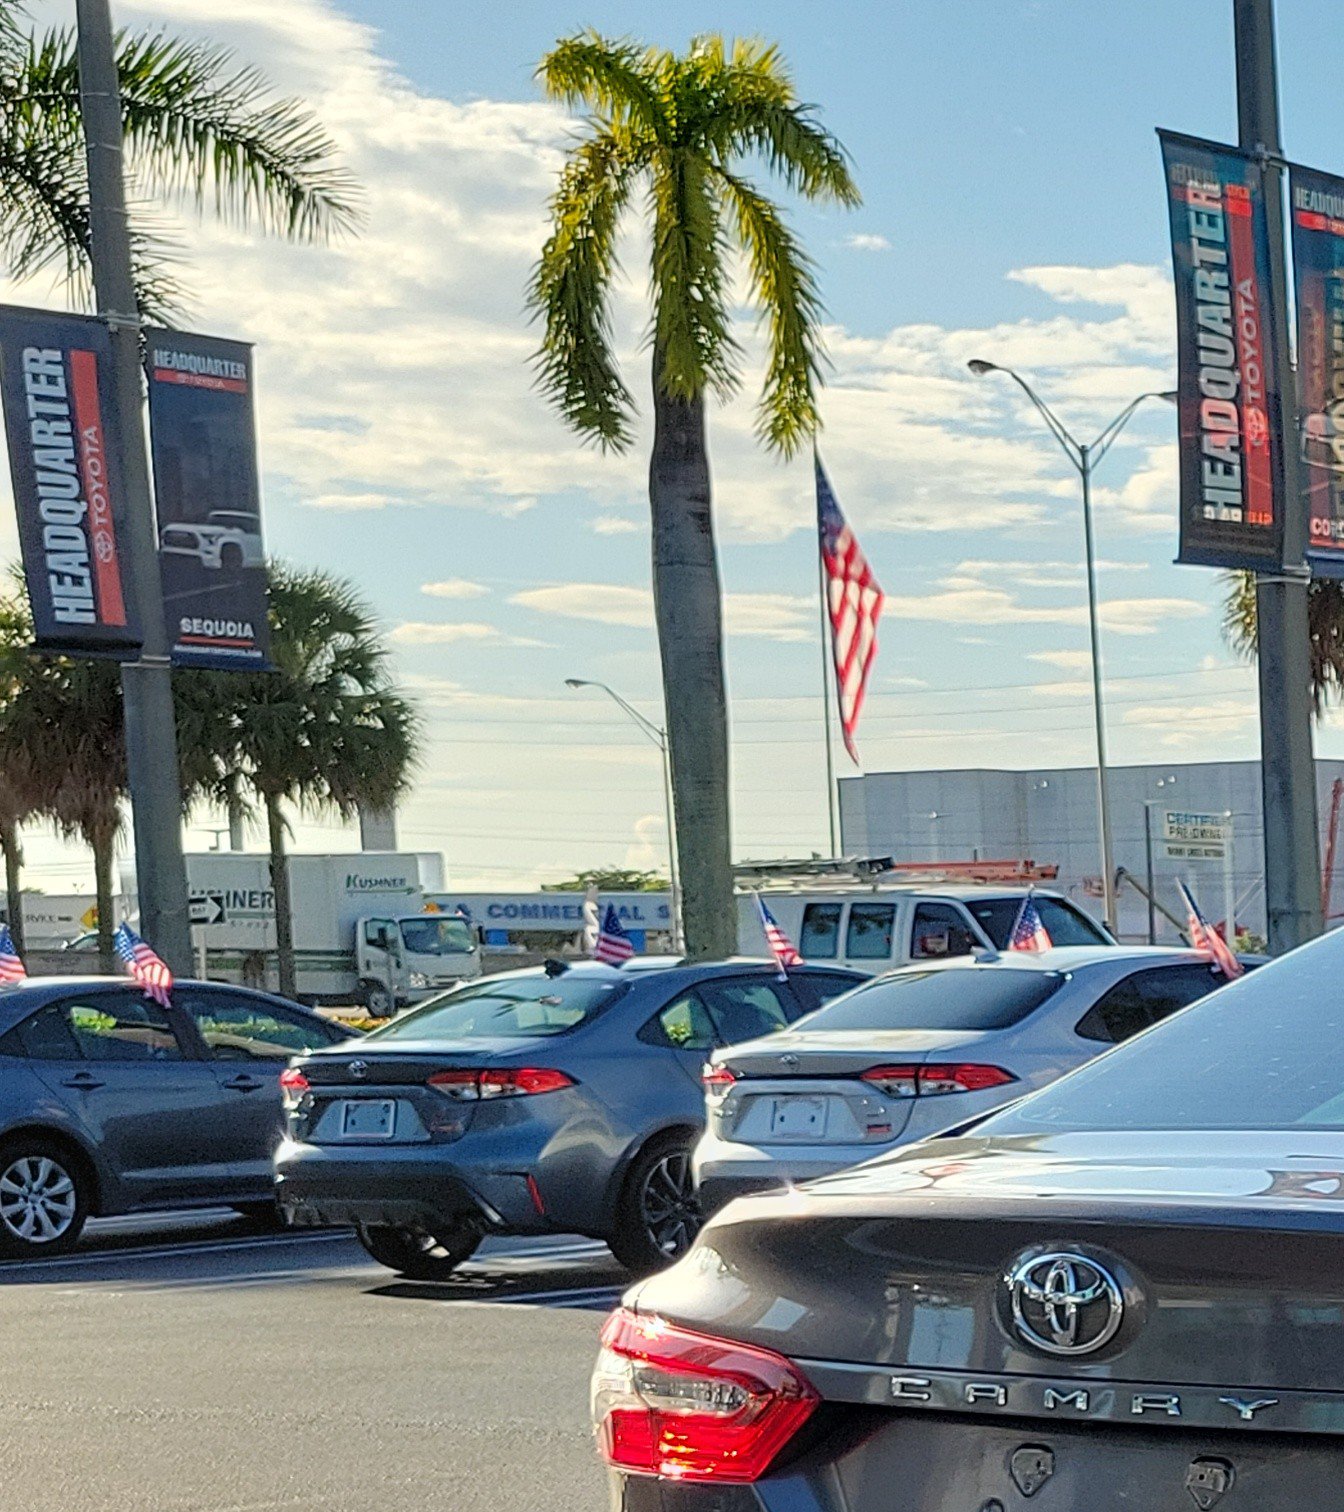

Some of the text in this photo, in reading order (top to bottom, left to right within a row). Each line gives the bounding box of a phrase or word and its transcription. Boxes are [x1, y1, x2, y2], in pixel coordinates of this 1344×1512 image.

[153, 349, 246, 379] HEADQUARTER
[1186, 179, 1244, 524] HEADQUARTER
[1237, 279, 1262, 404] TOYOTA
[22, 347, 96, 625] HEADQUARTER
[82, 426, 107, 526] TOYOTA
[180, 617, 254, 638] SEQUOIA
[891, 1376, 1278, 1421] CAMRY
